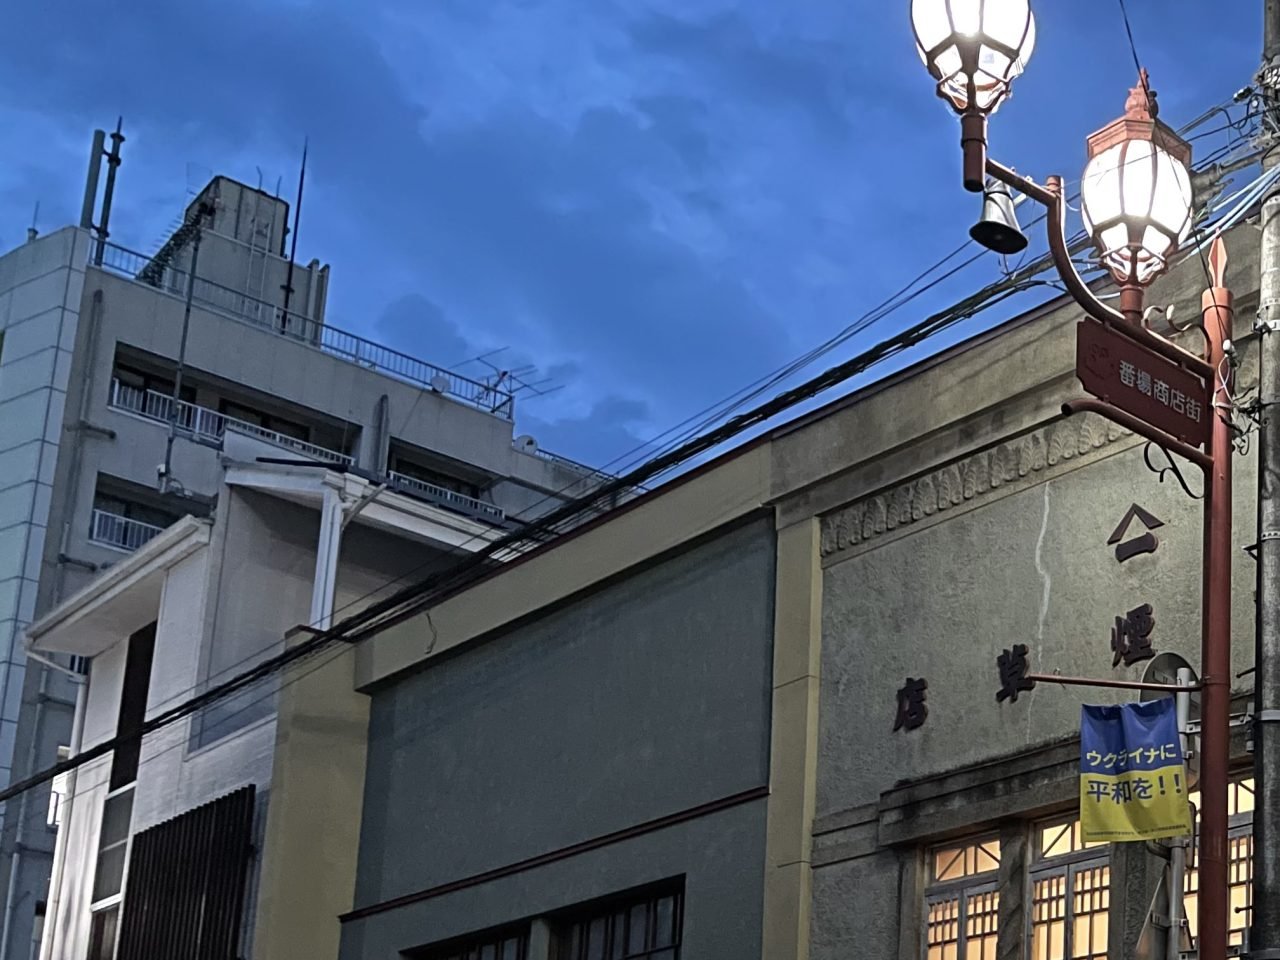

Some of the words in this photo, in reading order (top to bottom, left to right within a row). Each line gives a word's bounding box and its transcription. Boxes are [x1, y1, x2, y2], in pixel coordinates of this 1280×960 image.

[1119, 360, 1201, 423] 番場商店街
[1086, 743, 1177, 769] ウクライナに
[1086, 774, 1182, 804] 平和を！！
